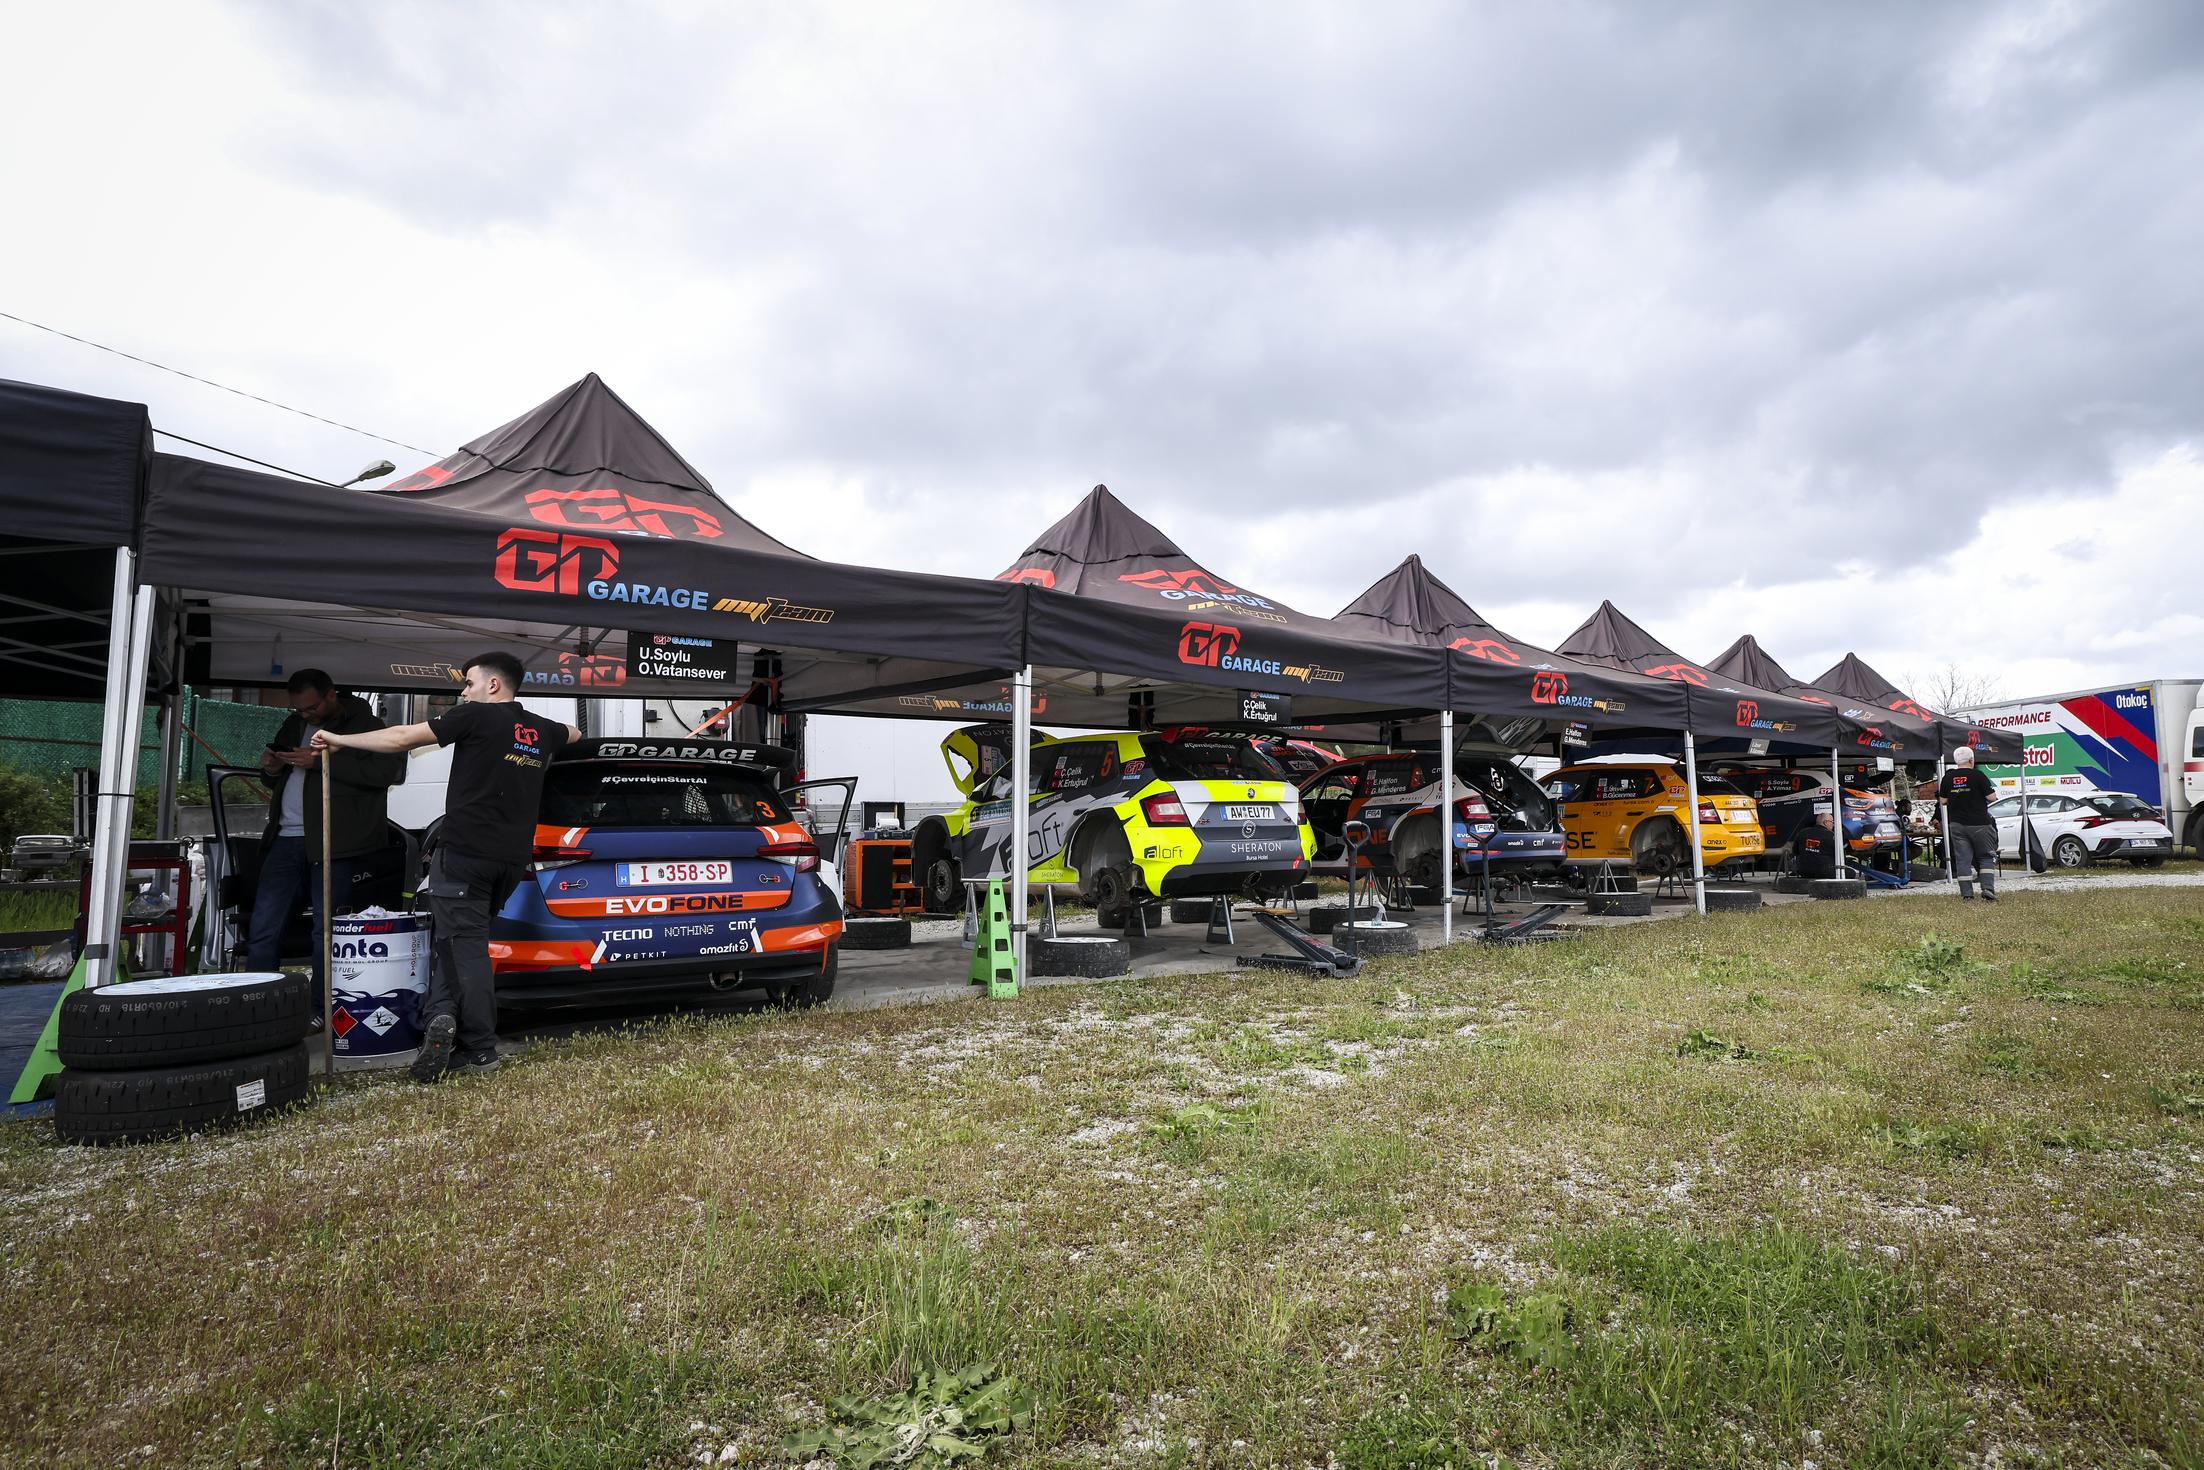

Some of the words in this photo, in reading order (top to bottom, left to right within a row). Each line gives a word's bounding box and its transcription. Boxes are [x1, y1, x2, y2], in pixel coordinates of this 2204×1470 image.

[587, 580, 709, 611] GARAGE
[1160, 589, 1275, 611] GARAGE
[672, 636, 712, 647] GARAGE
[639, 647, 691, 663] U.Soylu
[638, 662, 727, 680] O.Vatansever
[1221, 656, 1281, 676] GARAGE
[1243, 700, 1267, 712] Ç.Çelik
[1558, 695, 1593, 708] GARAGE
[2116, 693, 2148, 709] Otokoç
[1243, 710, 1278, 723] K.Ertuğrul
[1750, 719, 1774, 730] GARAGE
[1978, 711, 2051, 729] PERFORMANCE
[1204, 731, 1283, 745] GARAGE
[513, 743, 541, 755] GARAGE
[638, 746, 756, 761] GARAGE
[1101, 751, 1115, 777] 5
[756, 801, 776, 818] 3
[1231, 841, 1282, 854] SHERATON
[606, 894, 743, 914] EVOFONE
[602, 929, 653, 942] TECNO
[664, 924, 714, 938] NOTHING
[332, 938, 389, 959] anta
[626, 951, 667, 960] PETKIT
[700, 943, 738, 955] amazfit
